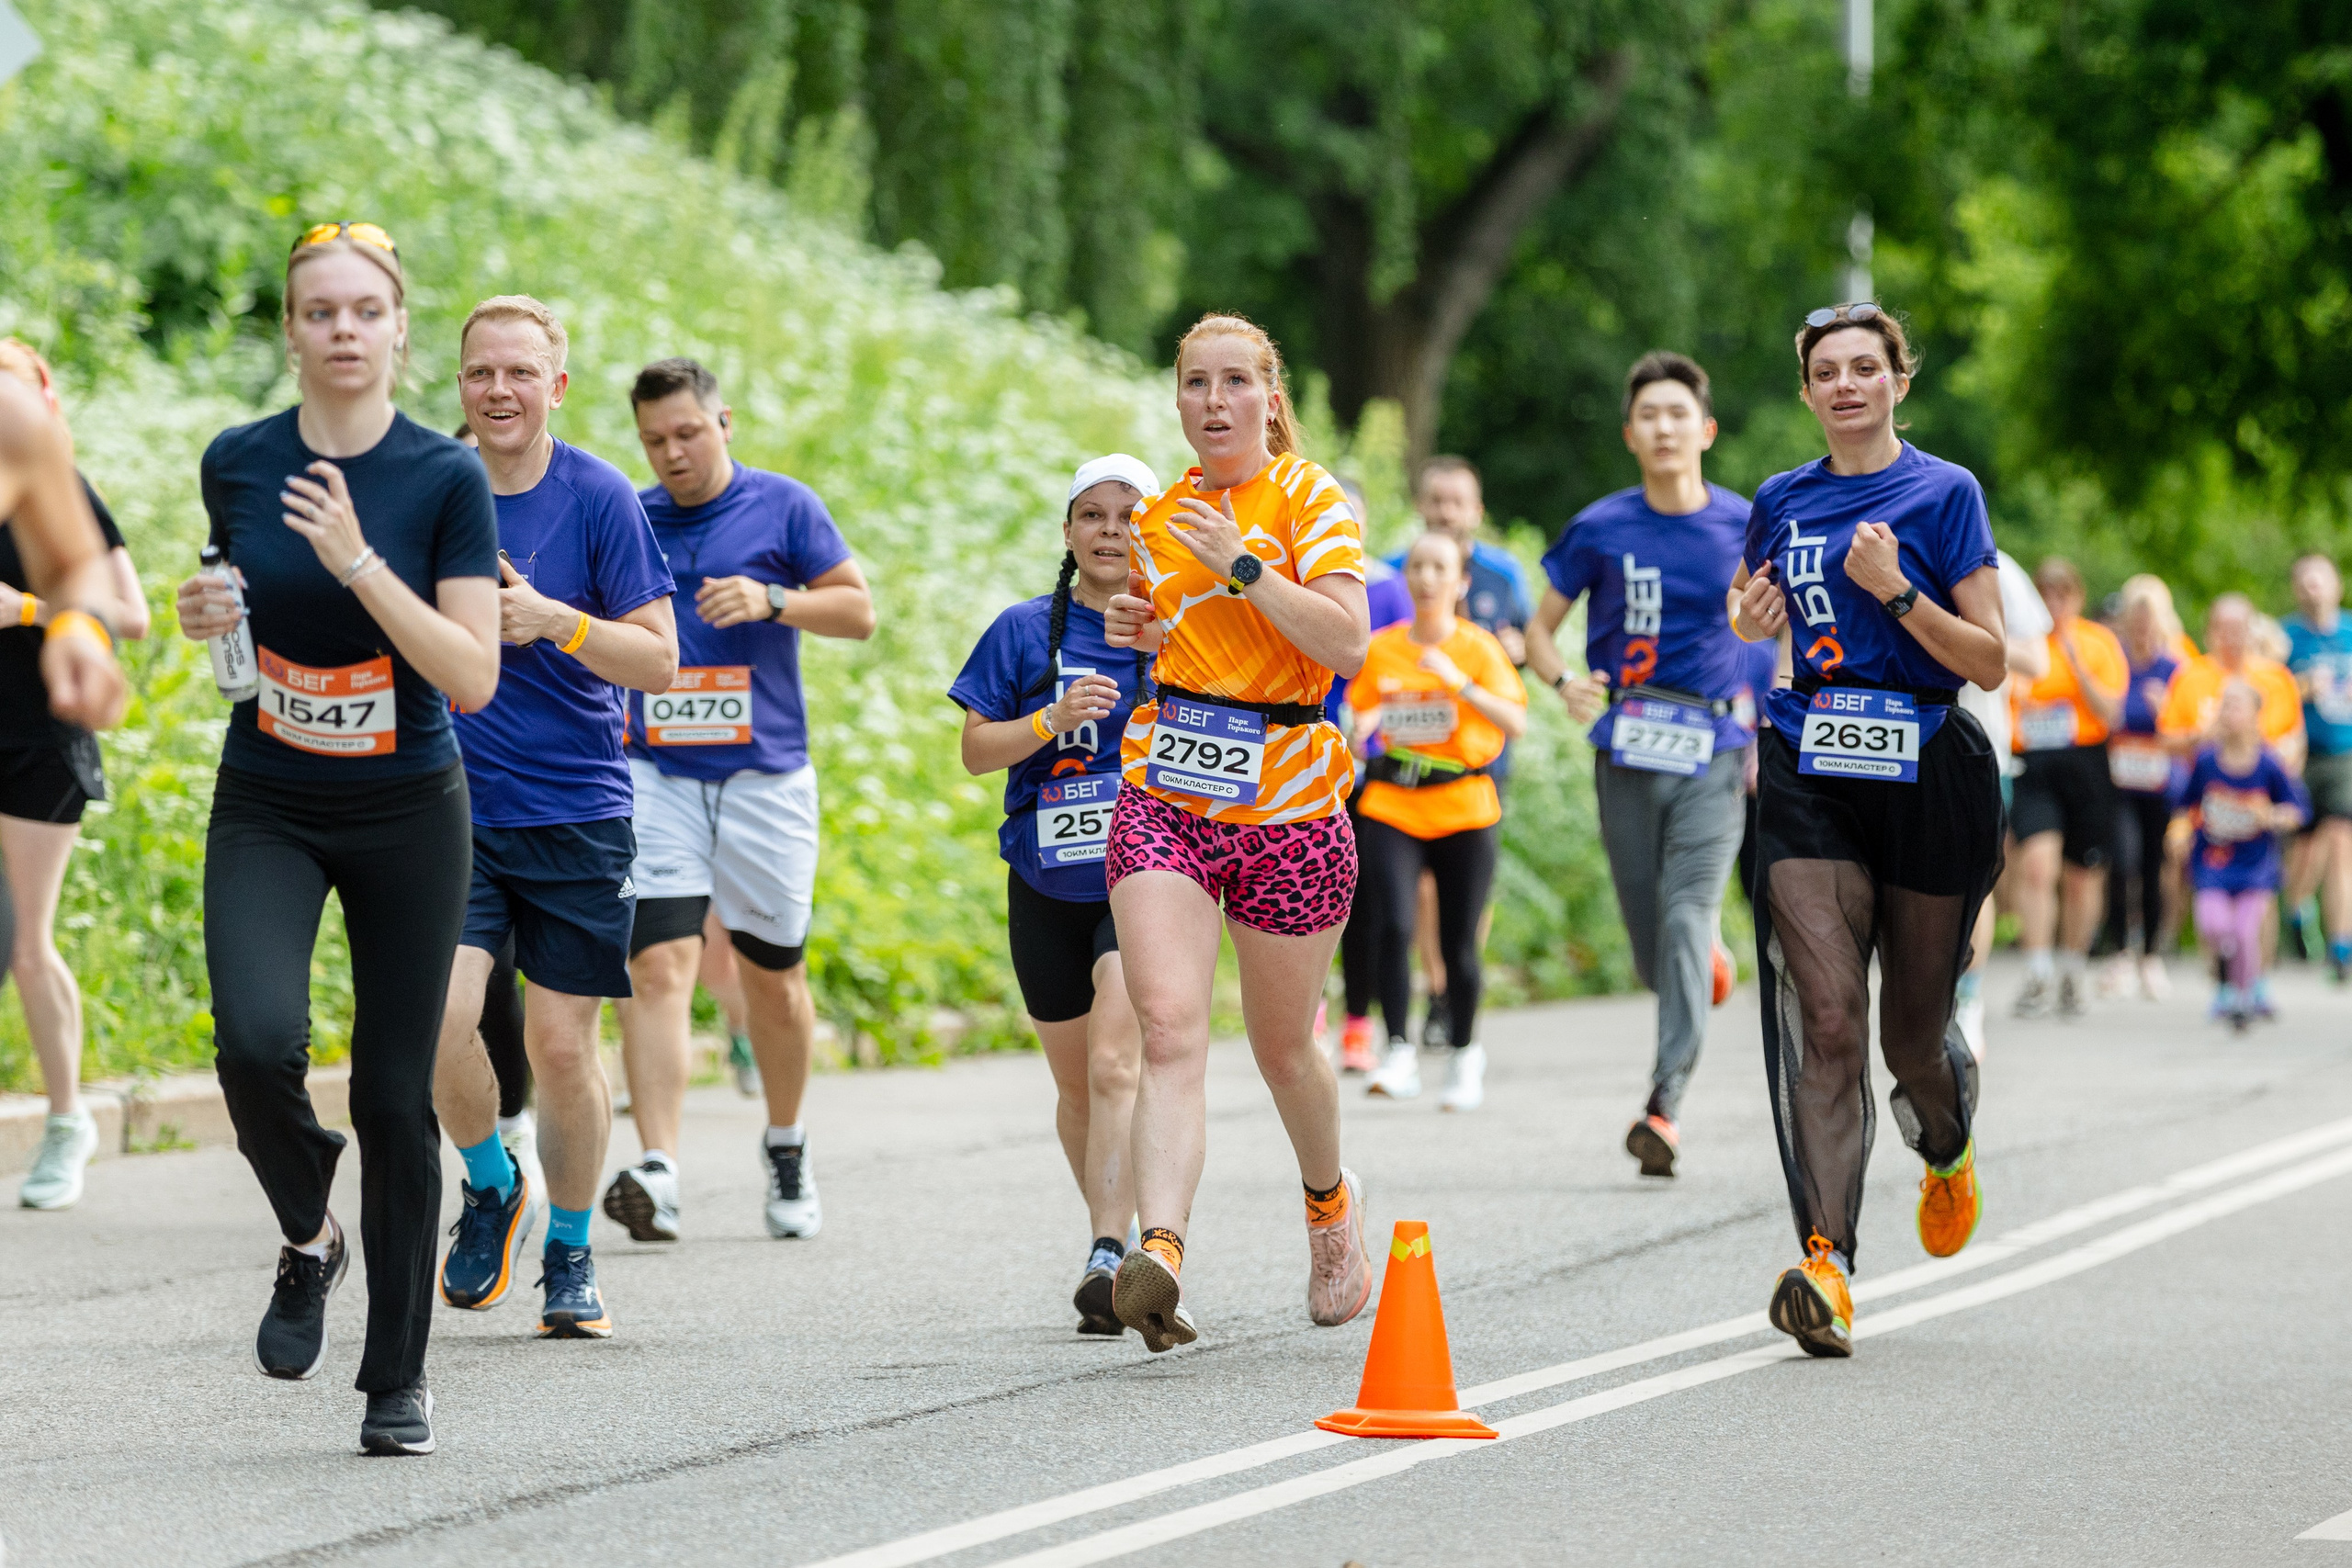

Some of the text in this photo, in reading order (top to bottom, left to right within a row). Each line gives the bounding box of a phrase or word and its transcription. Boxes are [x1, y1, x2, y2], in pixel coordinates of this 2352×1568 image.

[272, 689, 376, 728] 1547
[653, 699, 741, 720] 0470
[1227, 723, 1261, 735] Горького
[1228, 716, 1249, 726] Парк
[1627, 727, 1701, 753] 2773
[1814, 722, 1905, 752] 2631
[1157, 733, 1250, 775] 2792
[1819, 760, 1843, 768] 10КМ
[1844, 762, 1887, 772] КЛАСТЕР
[1162, 774, 1182, 784] 10КМ
[1183, 779, 1225, 792] КЛАСТЕР
[1063, 850, 1087, 858] 10КМ
